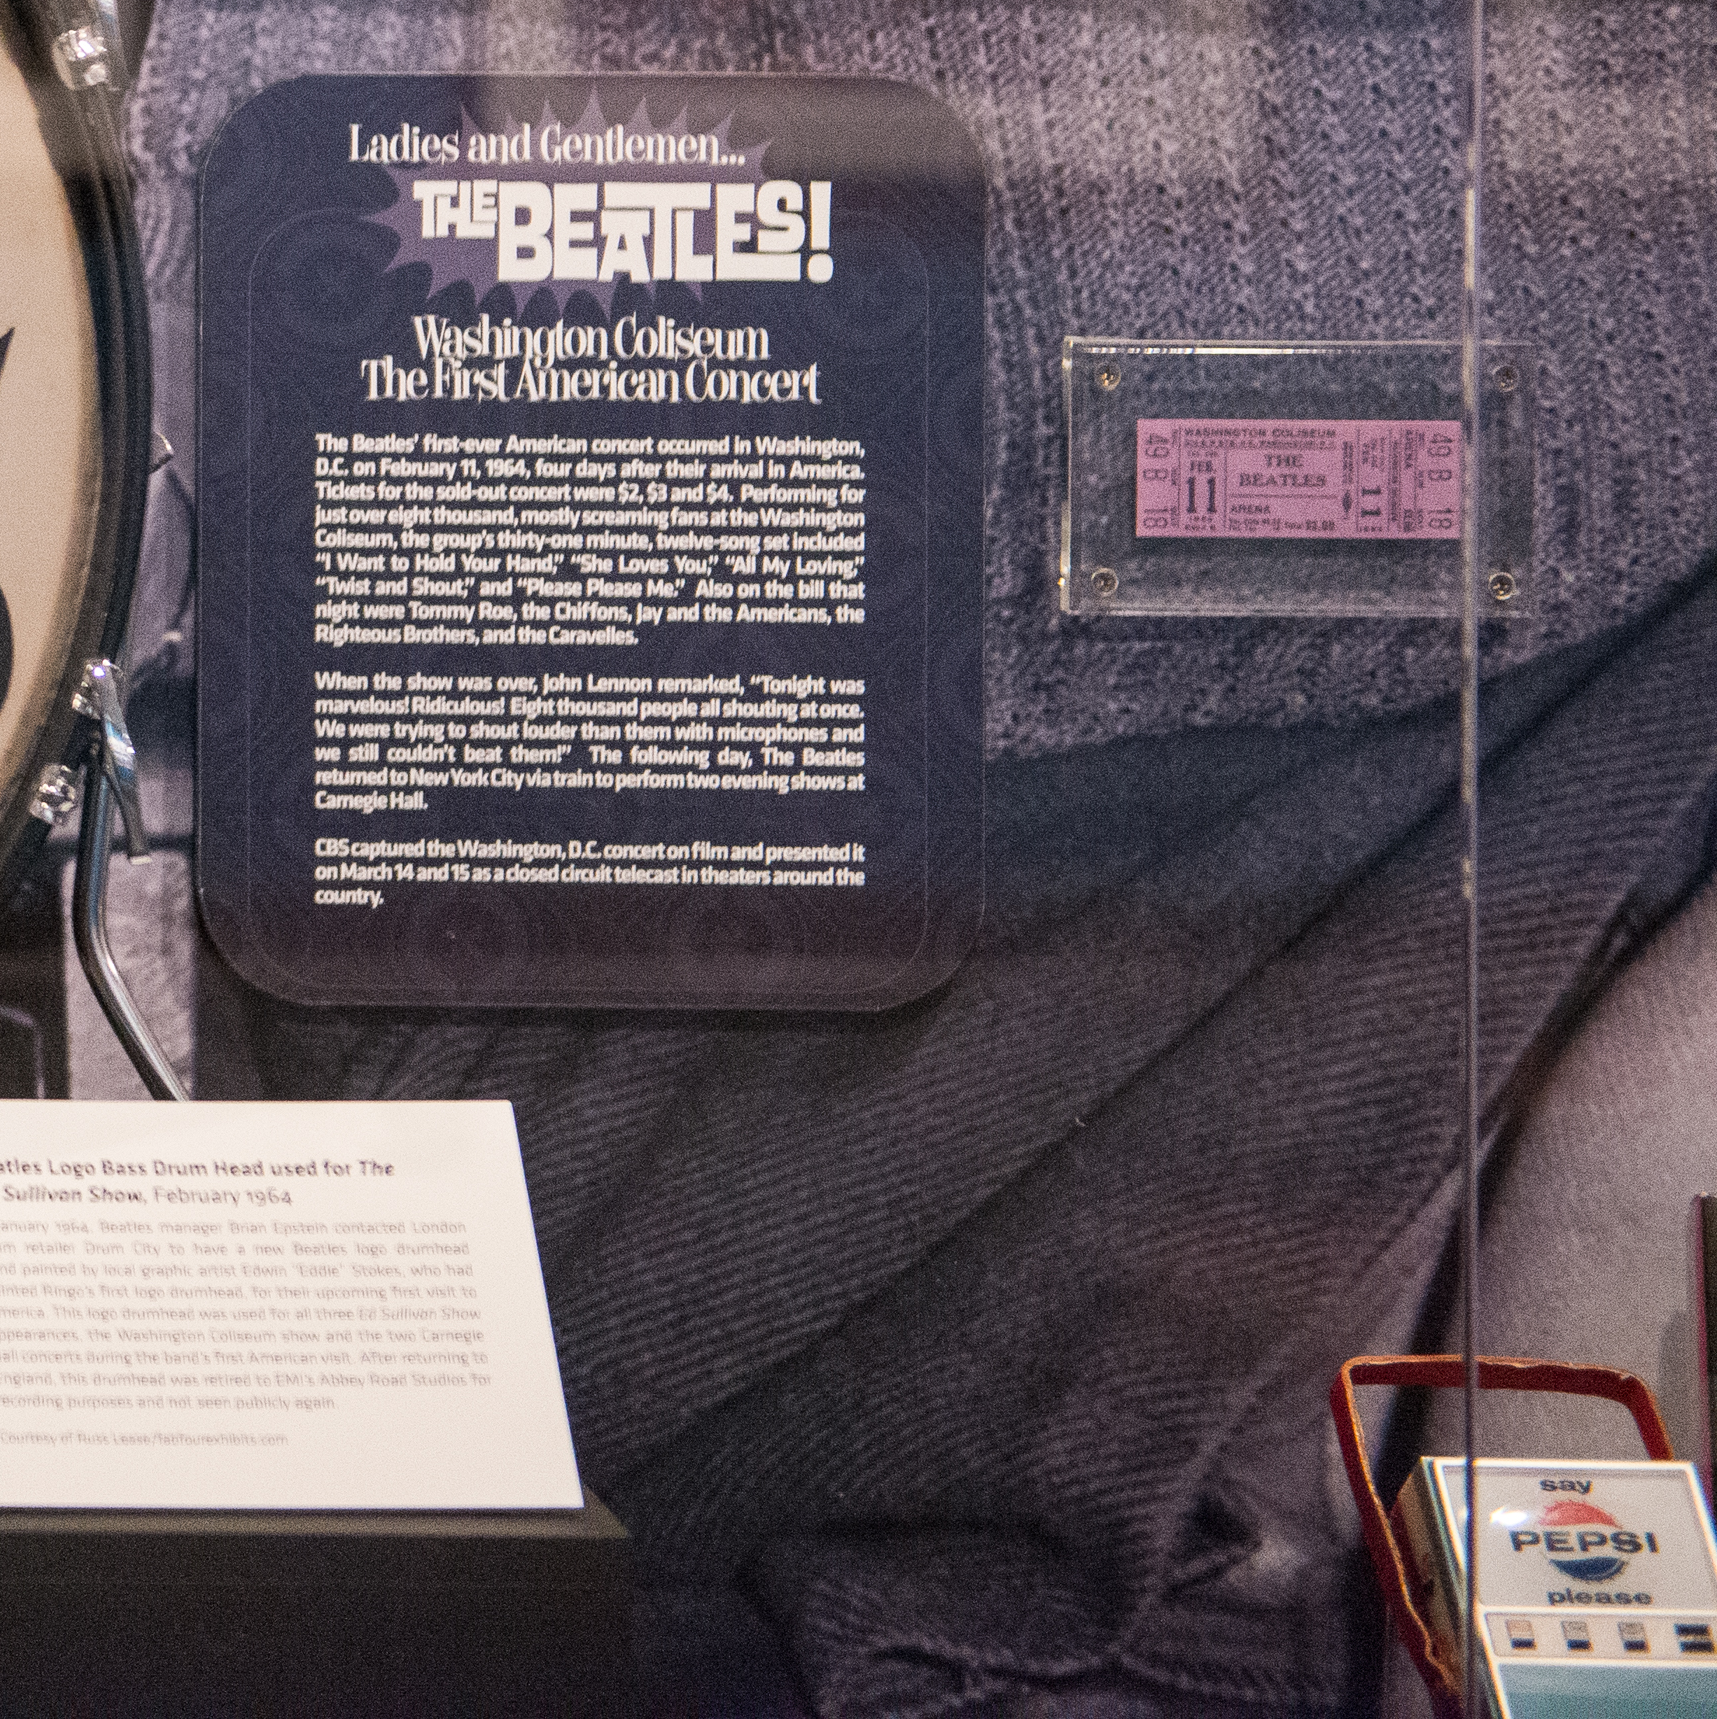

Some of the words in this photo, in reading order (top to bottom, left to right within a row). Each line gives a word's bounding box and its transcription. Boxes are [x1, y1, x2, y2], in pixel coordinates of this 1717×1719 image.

[350, 123, 460, 164] Ladies
[466, 122, 533, 166] and
[537, 121, 747, 167] Gentlemen...
[413, 180, 497, 240] THE
[497, 180, 835, 284] BEATLES!
[412, 313, 609, 370] Washington
[613, 314, 770, 359] Coliseum
[360, 354, 429, 402] The
[433, 354, 509, 402] First
[514, 355, 680, 403] American
[684, 359, 820, 404] Concert
[1185, 428, 1267, 438] WASHINGTON
[1271, 428, 1337, 440] COLISEUM
[315, 433, 349, 453] The
[351, 433, 419, 453] Beatles'
[422, 433, 503, 454] first-ever
[505, 434, 589, 454] American
[591, 437, 654, 455] concert
[656, 435, 731, 455] occurred
[733, 436, 752, 455] in
[755, 436, 866, 460] Washington,
[1265, 453, 1303, 469] THE
[1238, 472, 1328, 489] BEATLES
[1186, 476, 1218, 515] 11
[1230, 504, 1271, 515] ARENA
[314, 887, 384, 909] country.
[47, 1159, 97, 1180] Logo
[100, 1158, 148, 1177] Bass
[151, 1159, 209, 1177] Drum
[212, 1159, 266, 1178] Head
[269, 1159, 319, 1178] used
[321, 1158, 352, 1178] for
[357, 1158, 396, 1178] The
[2, 1184, 84, 1204] Sullivan
[87, 1184, 148, 1205] Show,
[152, 1185, 241, 1207] February
[244, 1186, 294, 1208] 1964
[1540, 1478, 1594, 1497] say
[1511, 1529, 1660, 1556] PEPSI
[1547, 1588, 1654, 1606] please
